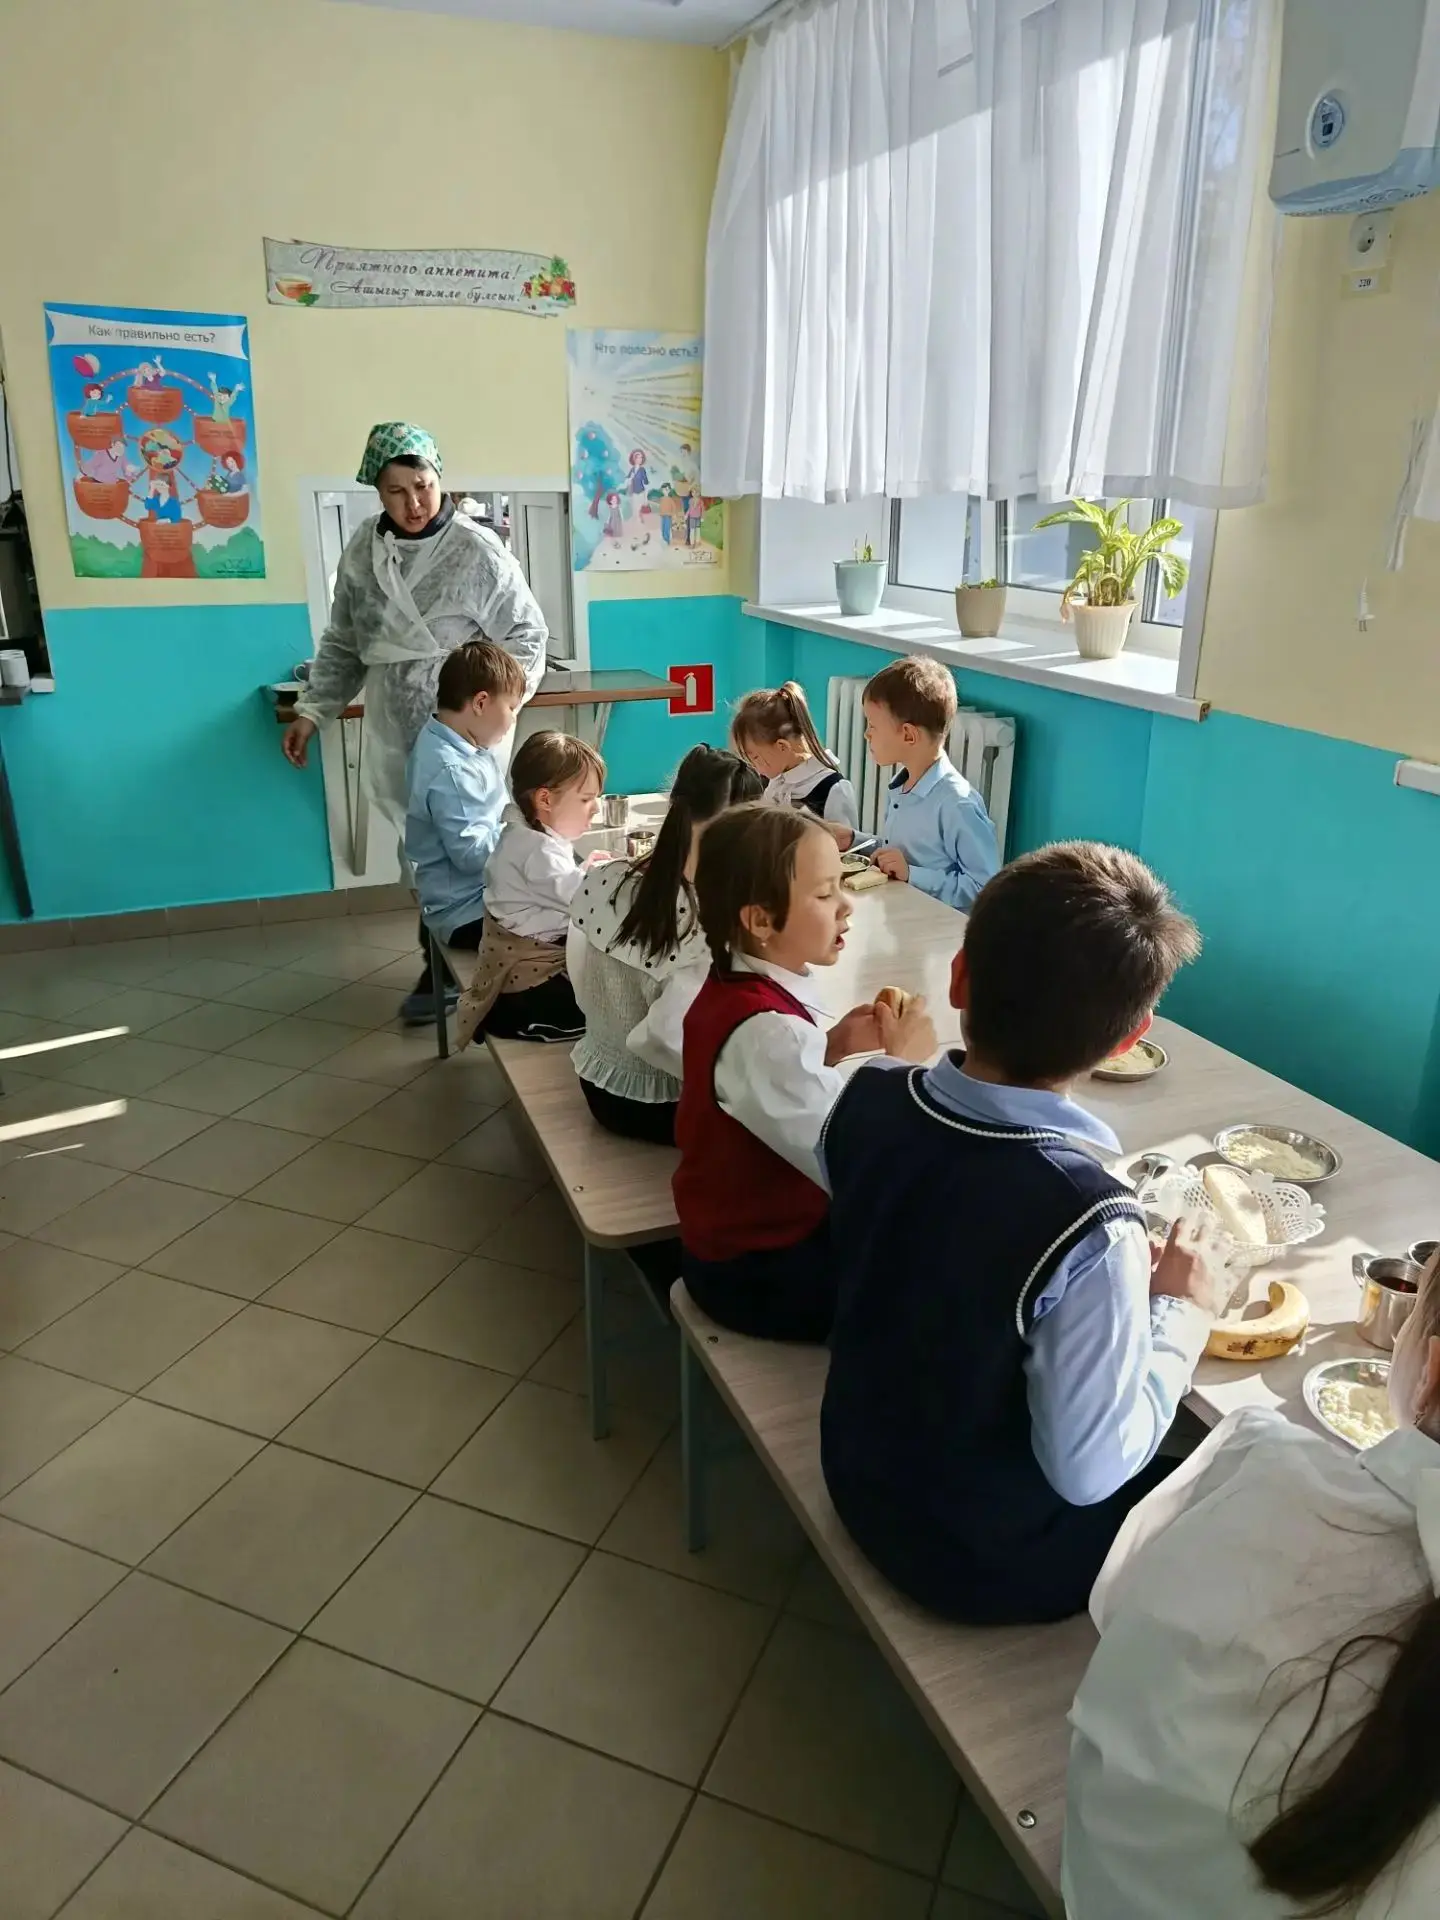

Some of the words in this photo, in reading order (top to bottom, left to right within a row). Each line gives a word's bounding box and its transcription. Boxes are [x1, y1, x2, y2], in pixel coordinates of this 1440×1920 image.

[88, 325, 112, 337] Как
[115, 329, 181, 341] правильно
[184, 332, 216, 343] есть?
